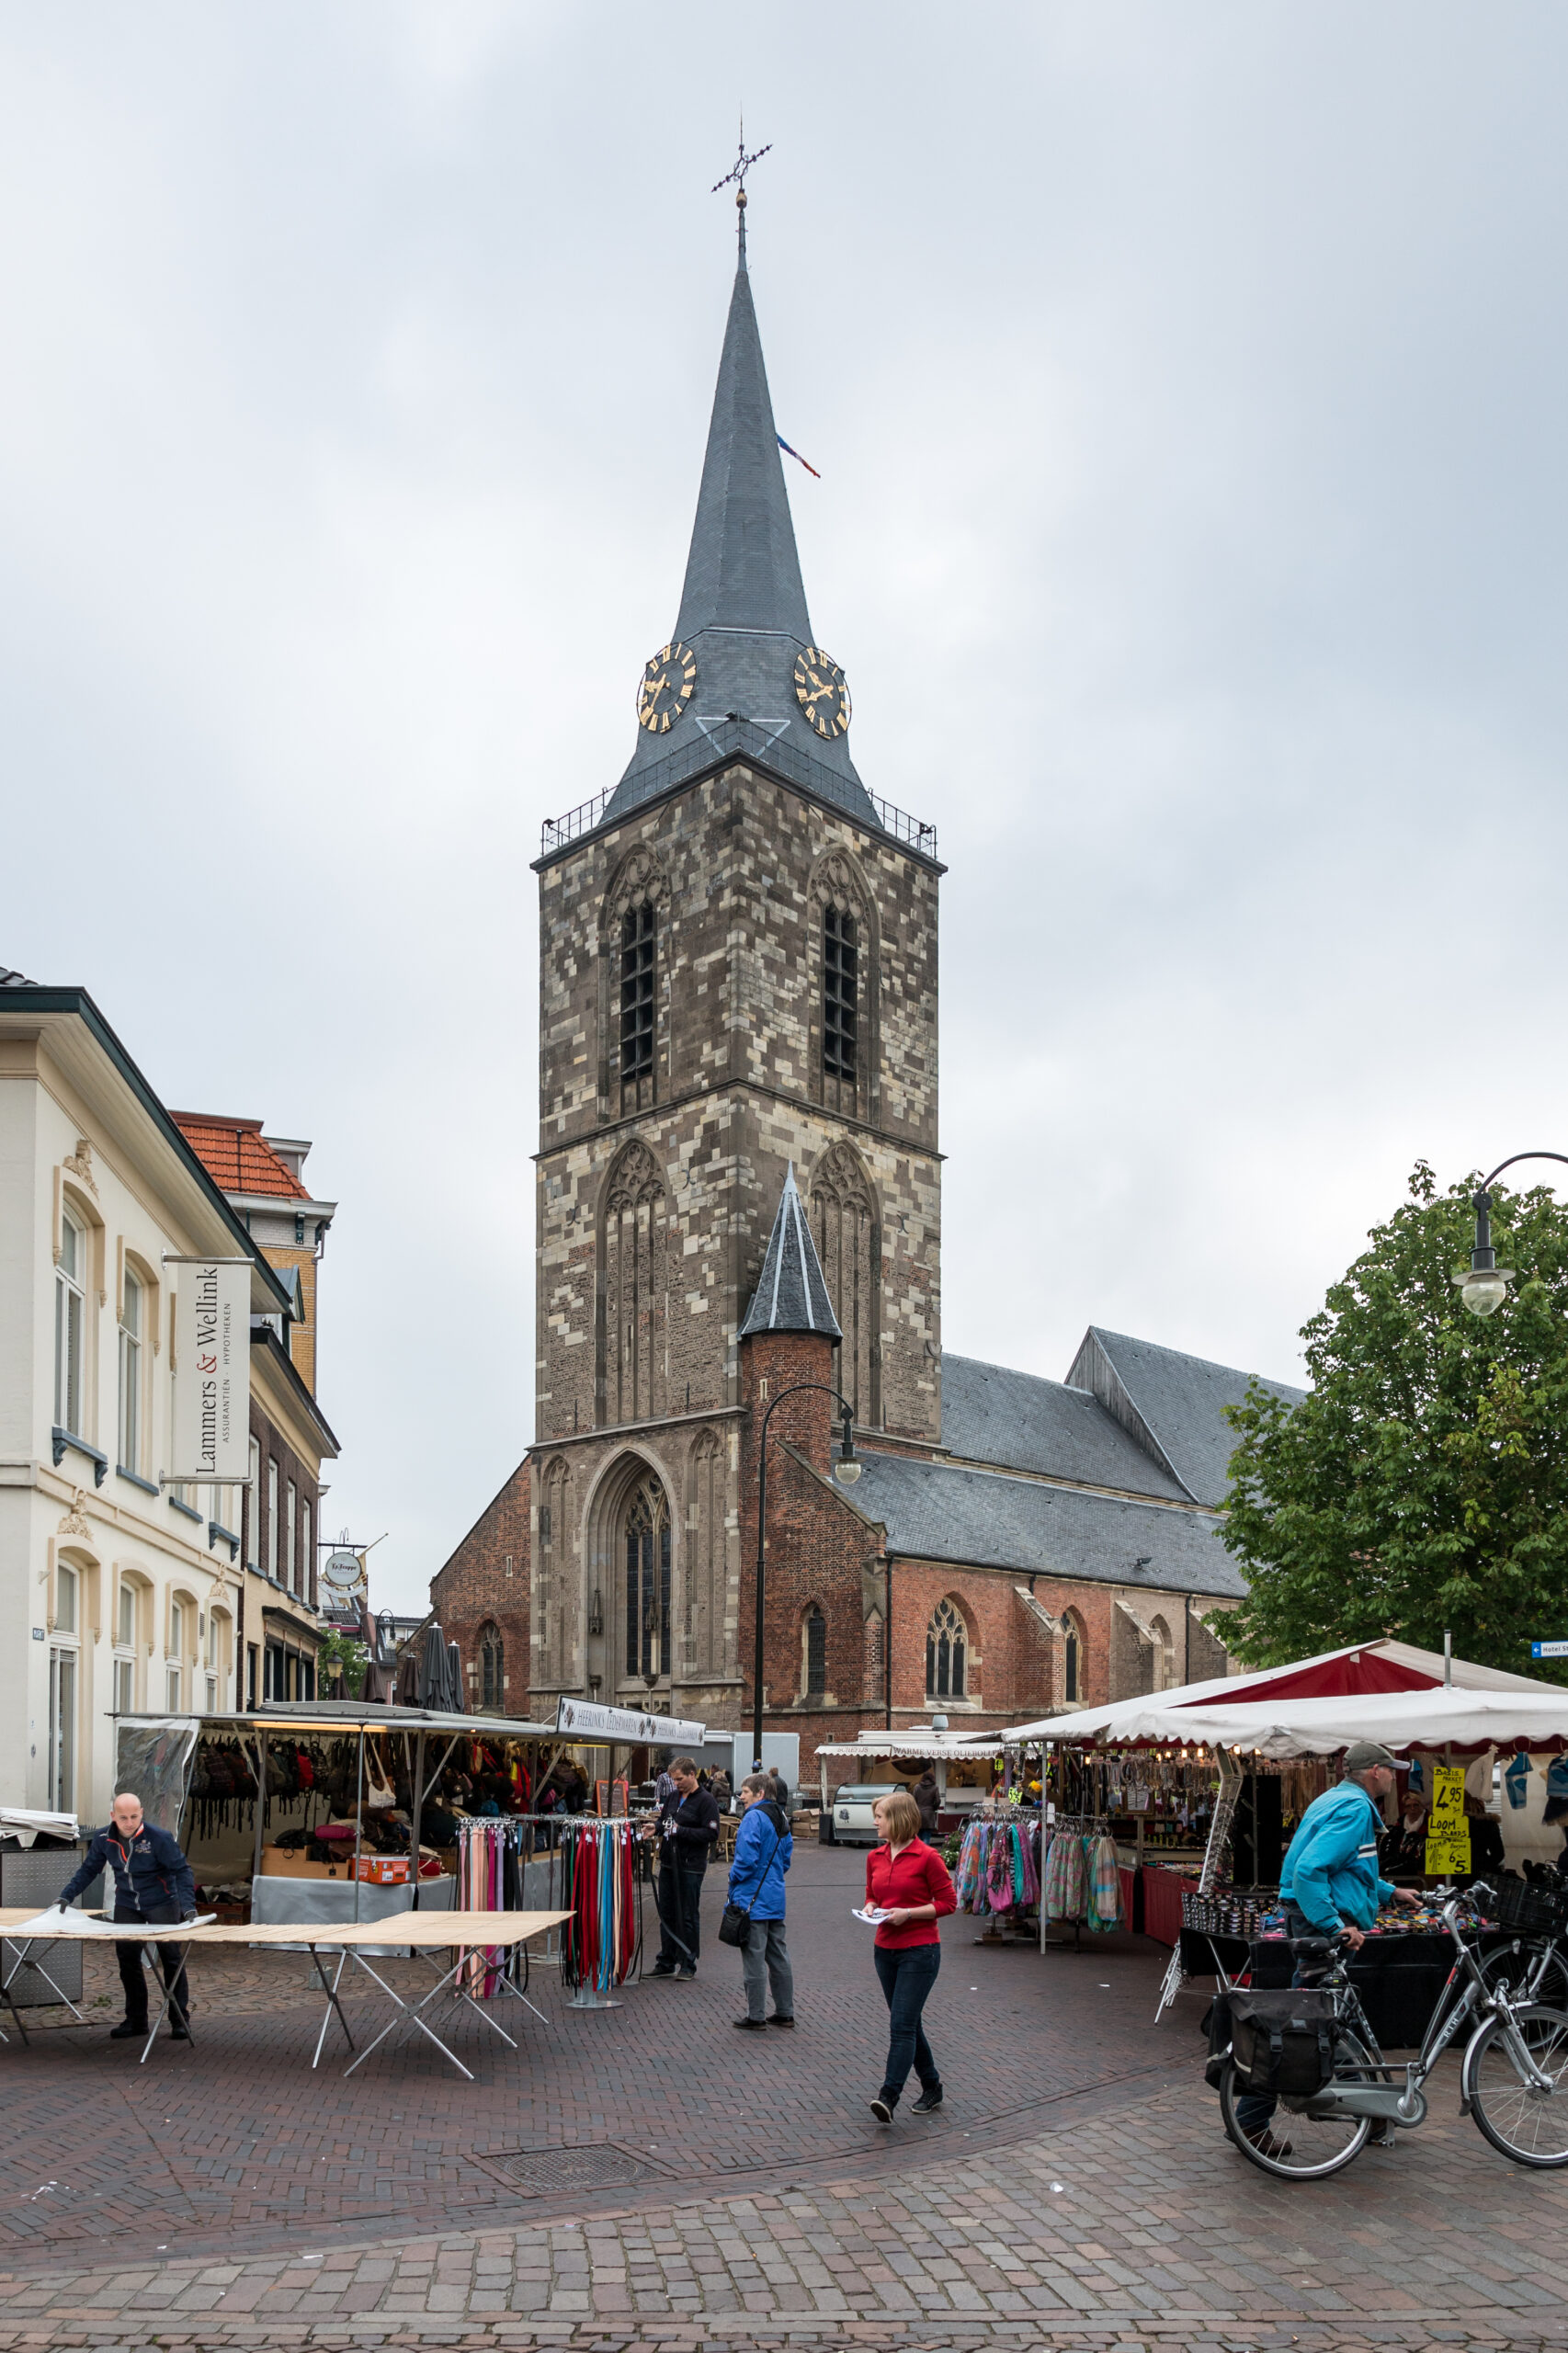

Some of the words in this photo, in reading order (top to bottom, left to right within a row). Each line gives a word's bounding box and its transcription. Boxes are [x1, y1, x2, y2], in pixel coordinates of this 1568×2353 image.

[196, 1267, 218, 1347] Wellink
[222, 1303, 231, 1364] HYPOTHEKEN
[196, 1353, 217, 1374] &
[196, 1381, 217, 1473] Lammers
[893, 1746, 925, 1755] WARME
[1442, 2018, 1460, 2038] RIH
